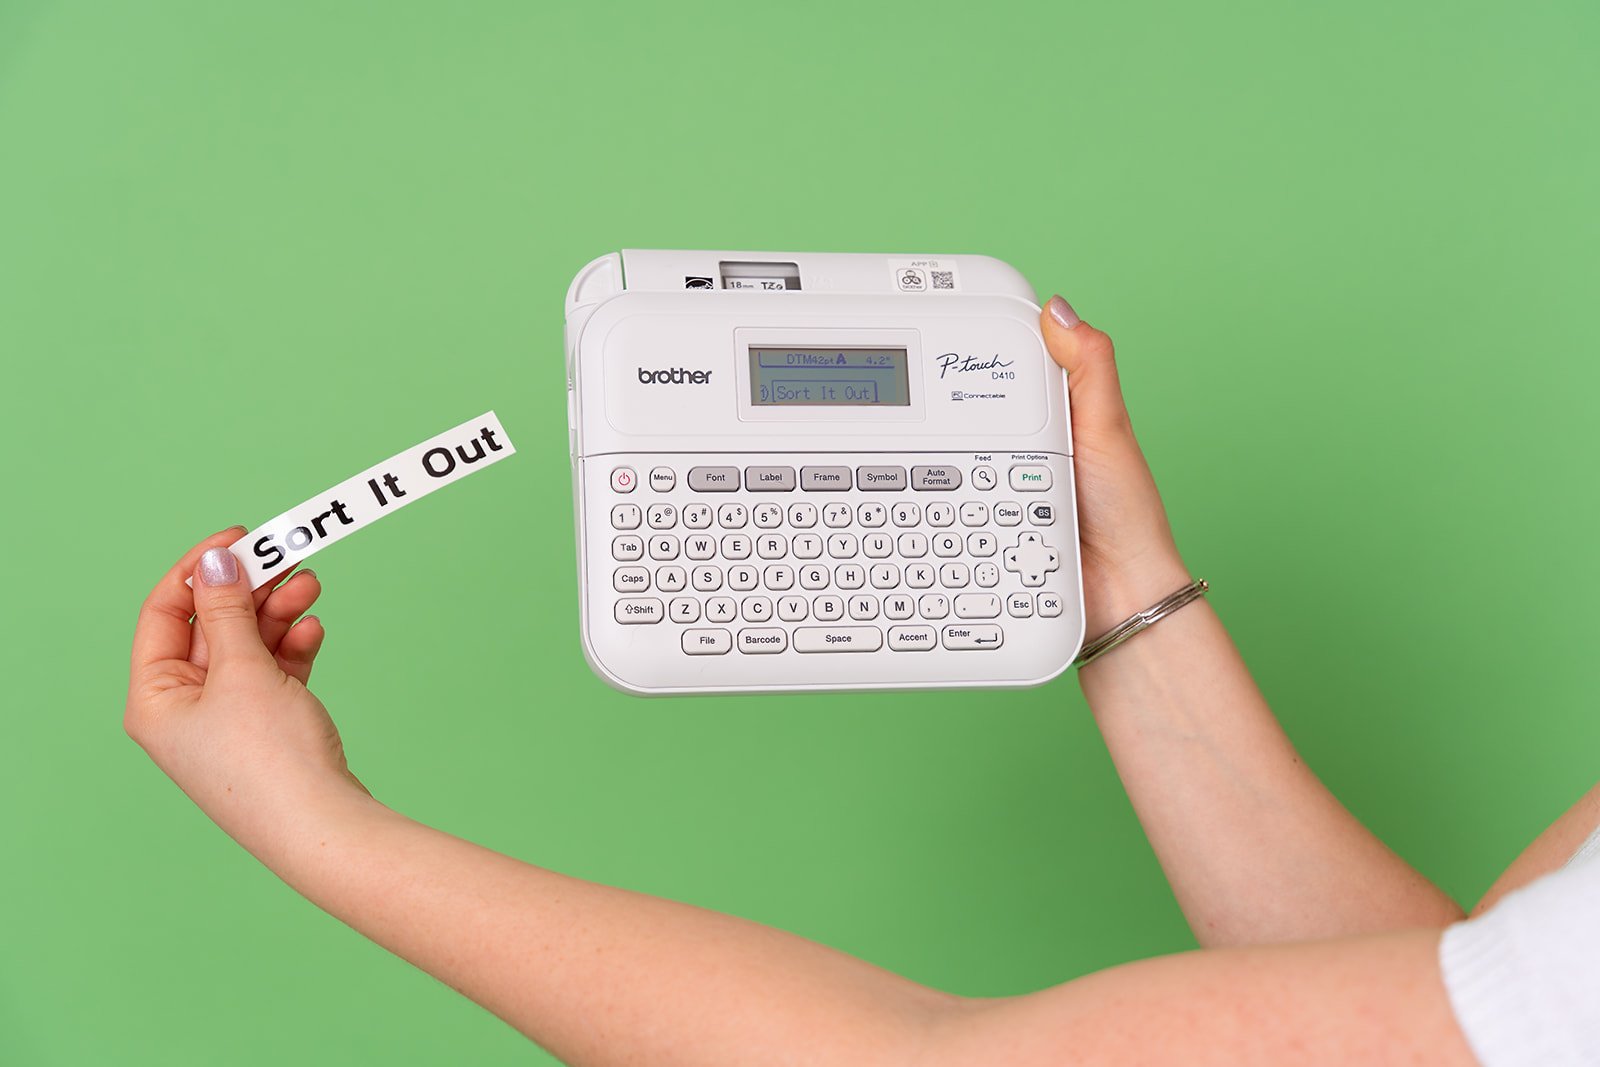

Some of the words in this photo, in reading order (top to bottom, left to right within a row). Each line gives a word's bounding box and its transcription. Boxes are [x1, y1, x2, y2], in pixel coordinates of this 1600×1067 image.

[936, 353, 1014, 379] P-touch
[638, 367, 712, 384] brother
[992, 371, 1015, 380] D410
[777, 386, 810, 400] Sort
[822, 386, 836, 400] It
[845, 385, 870, 400] Out
[760, 473, 783, 481] Label
[813, 473, 840, 481] Frame
[867, 473, 897, 482] Symbol
[927, 469, 945, 477] Auto
[1022, 473, 1042, 481] Print
[706, 474, 725, 482] Font
[253, 499, 354, 570] Sort
[367, 472, 407, 507] It
[421, 427, 503, 478] Out
[655, 513, 662, 522] 2
[691, 513, 698, 522] 3
[726, 513, 733, 522] 4
[761, 513, 768, 522] 5
[796, 513, 802, 522] 6
[831, 512, 837, 521] 7
[865, 512, 872, 521] 8
[899, 511, 907, 521] 9
[934, 511, 941, 521] 0
[999, 509, 1019, 517] Clear
[1038, 509, 1050, 517] BS
[620, 543, 637, 551] Tab
[660, 541, 670, 551] Q
[695, 541, 707, 550] W
[733, 541, 741, 550] E
[769, 541, 777, 550] R
[804, 540, 812, 550] T
[839, 540, 847, 549] Y
[874, 540, 882, 550] U
[943, 539, 953, 549] O
[979, 539, 987, 548] P
[622, 575, 644, 584] Caps
[667, 573, 676, 583] A
[704, 573, 712, 583] S
[740, 572, 749, 582] D
[776, 572, 783, 581] F
[810, 571, 820, 581] G
[846, 571, 854, 581] H
[882, 571, 889, 581] J
[917, 571, 925, 580] K
[952, 571, 959, 580] L
[753, 604, 762, 613] C
[789, 603, 798, 612] V
[825, 603, 834, 612] B
[860, 602, 869, 611] N
[895, 602, 905, 611] M
[1045, 600, 1057, 608] OK
[634, 606, 654, 614] Shift
[682, 605, 690, 614] Z
[717, 604, 726, 614] X
[899, 633, 927, 641] Accent
[949, 629, 970, 637] Enter
[700, 637, 715, 645] File
[745, 636, 780, 644] Barcode
[825, 635, 852, 644] Space
